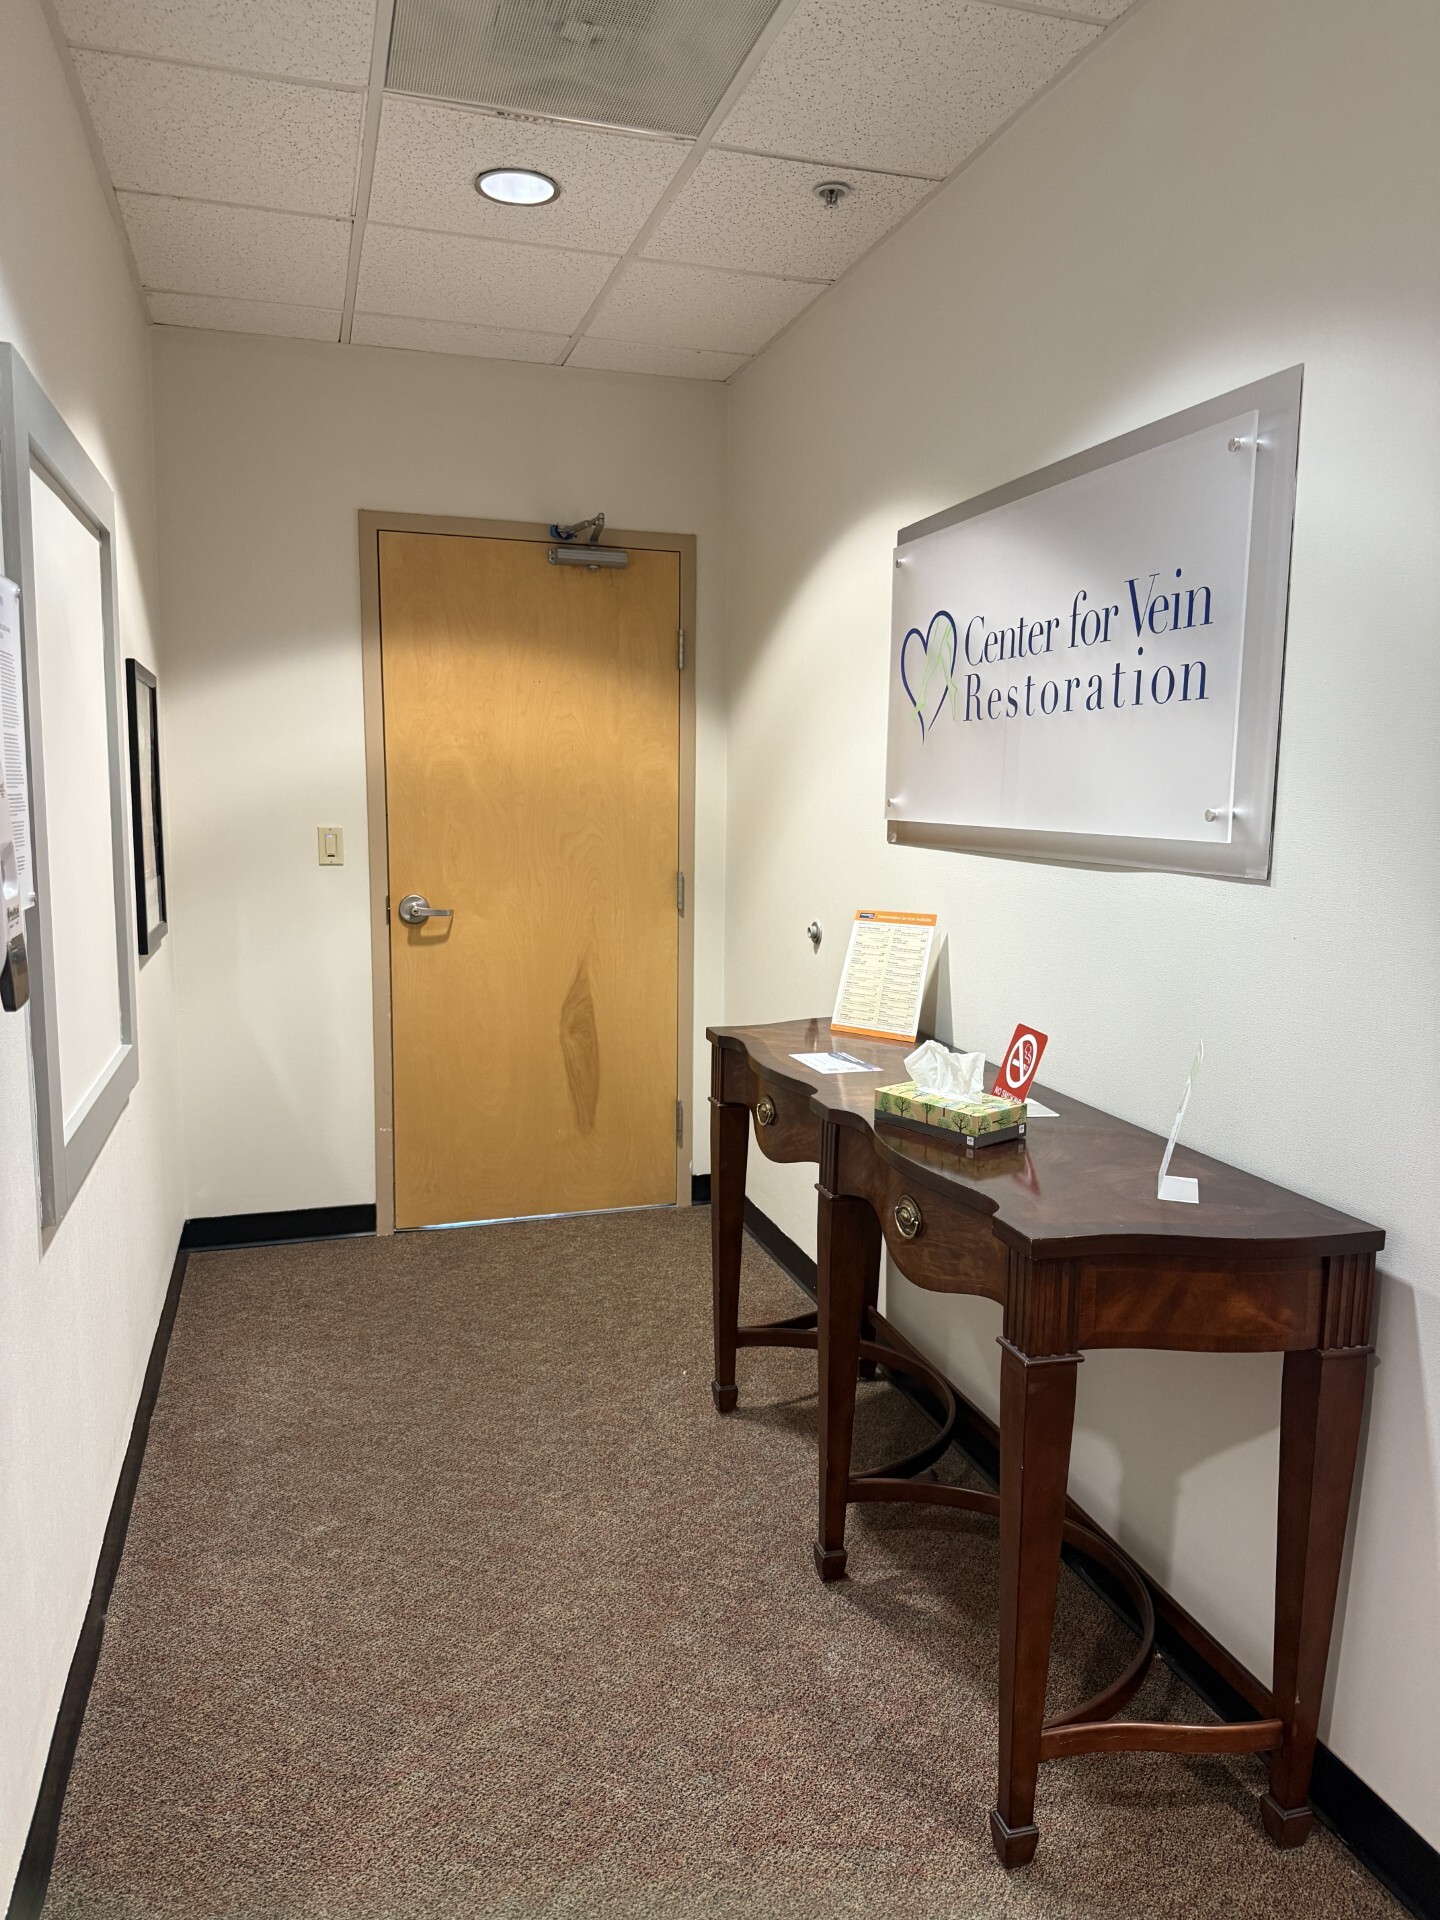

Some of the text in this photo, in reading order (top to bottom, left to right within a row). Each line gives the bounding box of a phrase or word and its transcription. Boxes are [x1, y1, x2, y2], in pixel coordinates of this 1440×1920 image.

[965, 568, 1213, 666] Center for Vein
[963, 647, 1209, 722] Restoration
[994, 1085, 1002, 1096] NO
